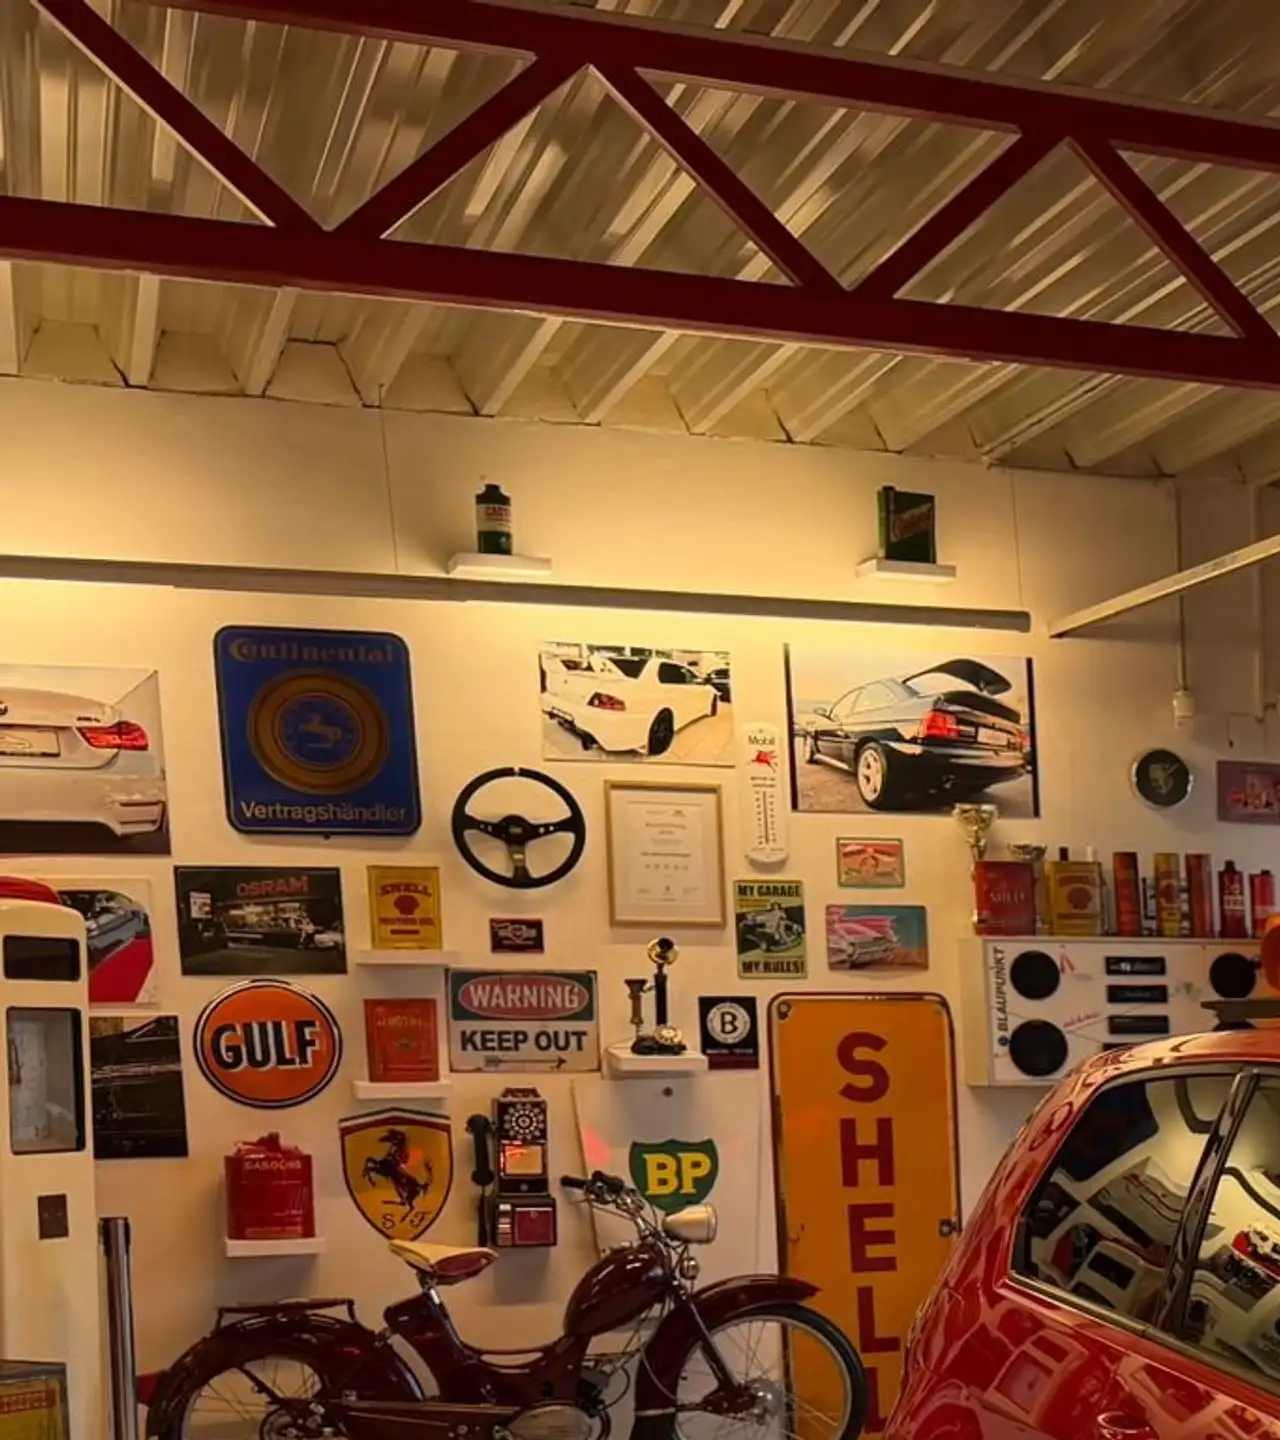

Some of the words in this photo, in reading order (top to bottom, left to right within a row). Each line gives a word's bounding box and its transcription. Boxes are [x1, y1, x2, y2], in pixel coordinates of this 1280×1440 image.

[240, 800, 407, 823] Vertragshändler
[236, 876, 309, 897] OSRAM
[469, 984, 580, 1009] WARNING
[991, 946, 1008, 1032] BLAUPUNKT
[211, 1019, 319, 1071] GULF
[460, 1029, 528, 1052] KEEP
[534, 1030, 588, 1052] OUT
[643, 1152, 711, 1196] BP
[836, 1031, 902, 1435] SHELL
